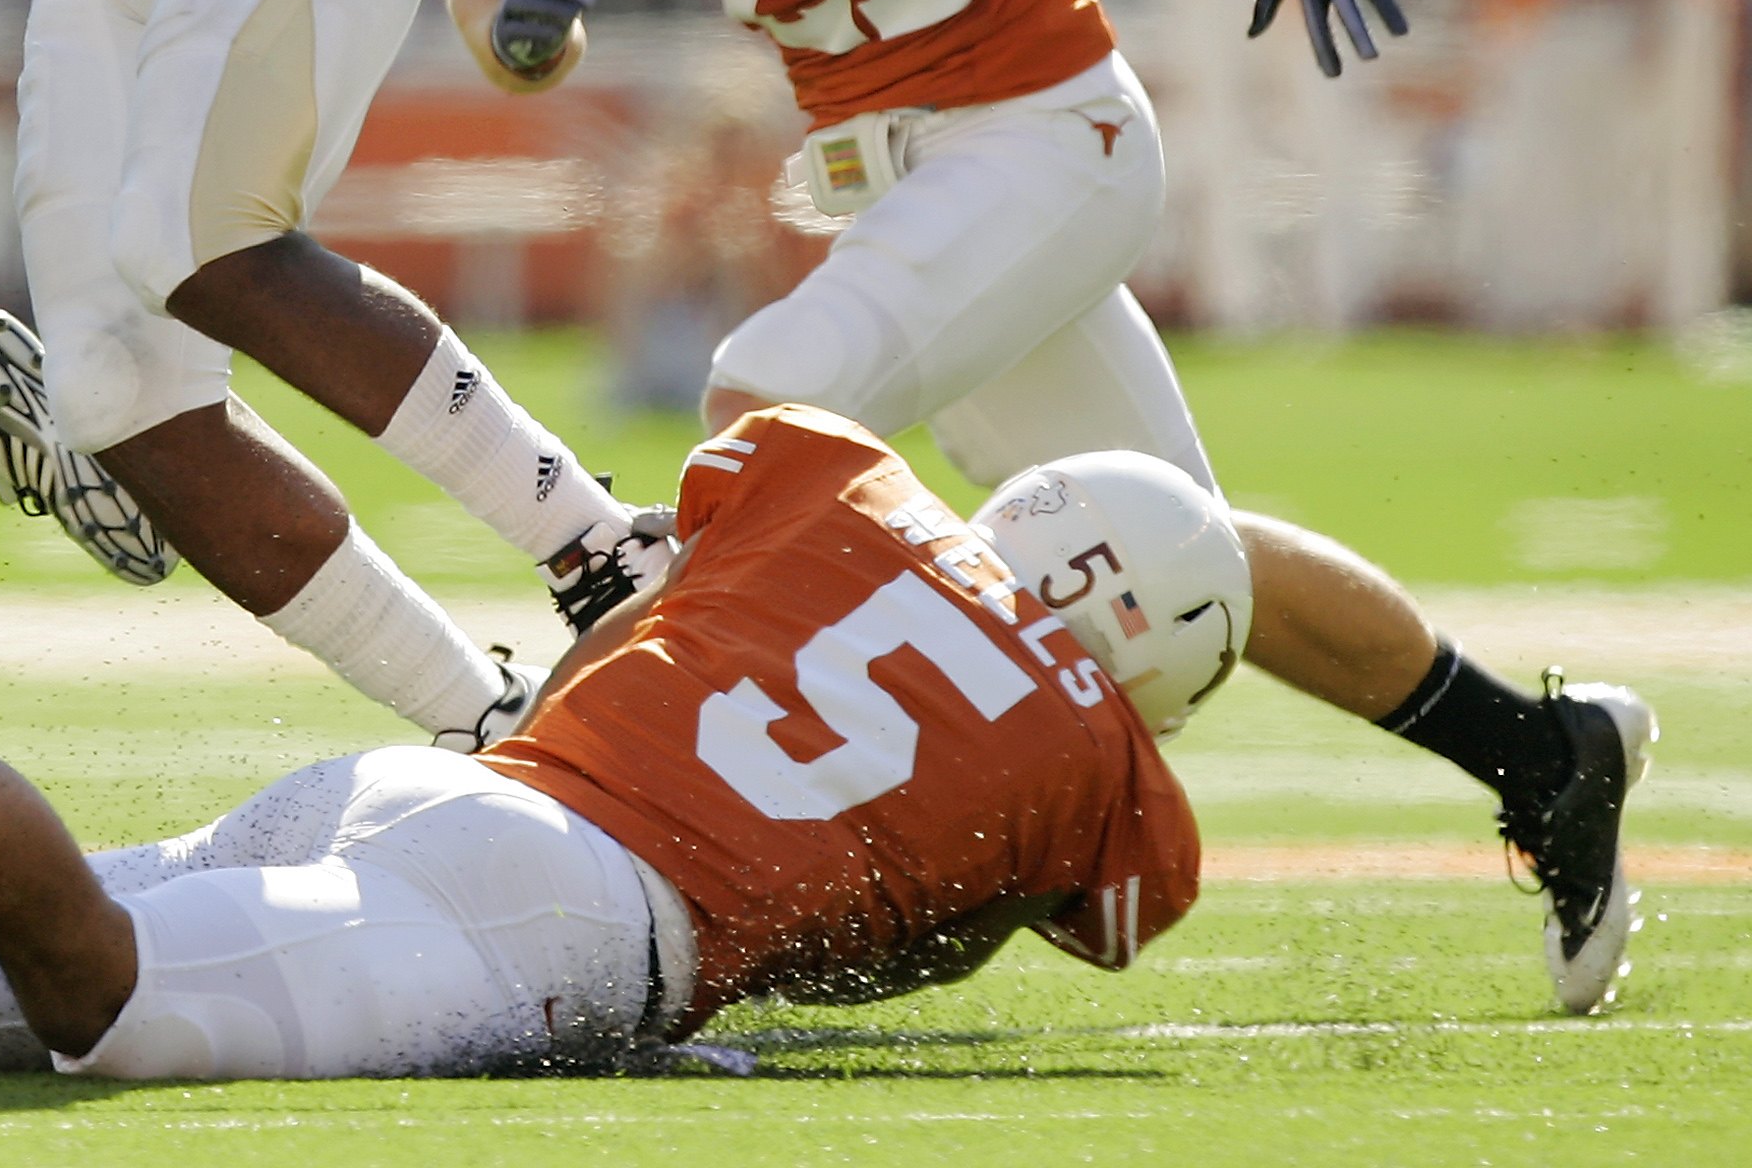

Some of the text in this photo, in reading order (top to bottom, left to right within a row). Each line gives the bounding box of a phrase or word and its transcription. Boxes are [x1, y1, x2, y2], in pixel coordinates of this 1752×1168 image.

[885, 492, 1104, 708] WELLS
[1040, 542, 1122, 609] 5
[697, 570, 1037, 822] 5
